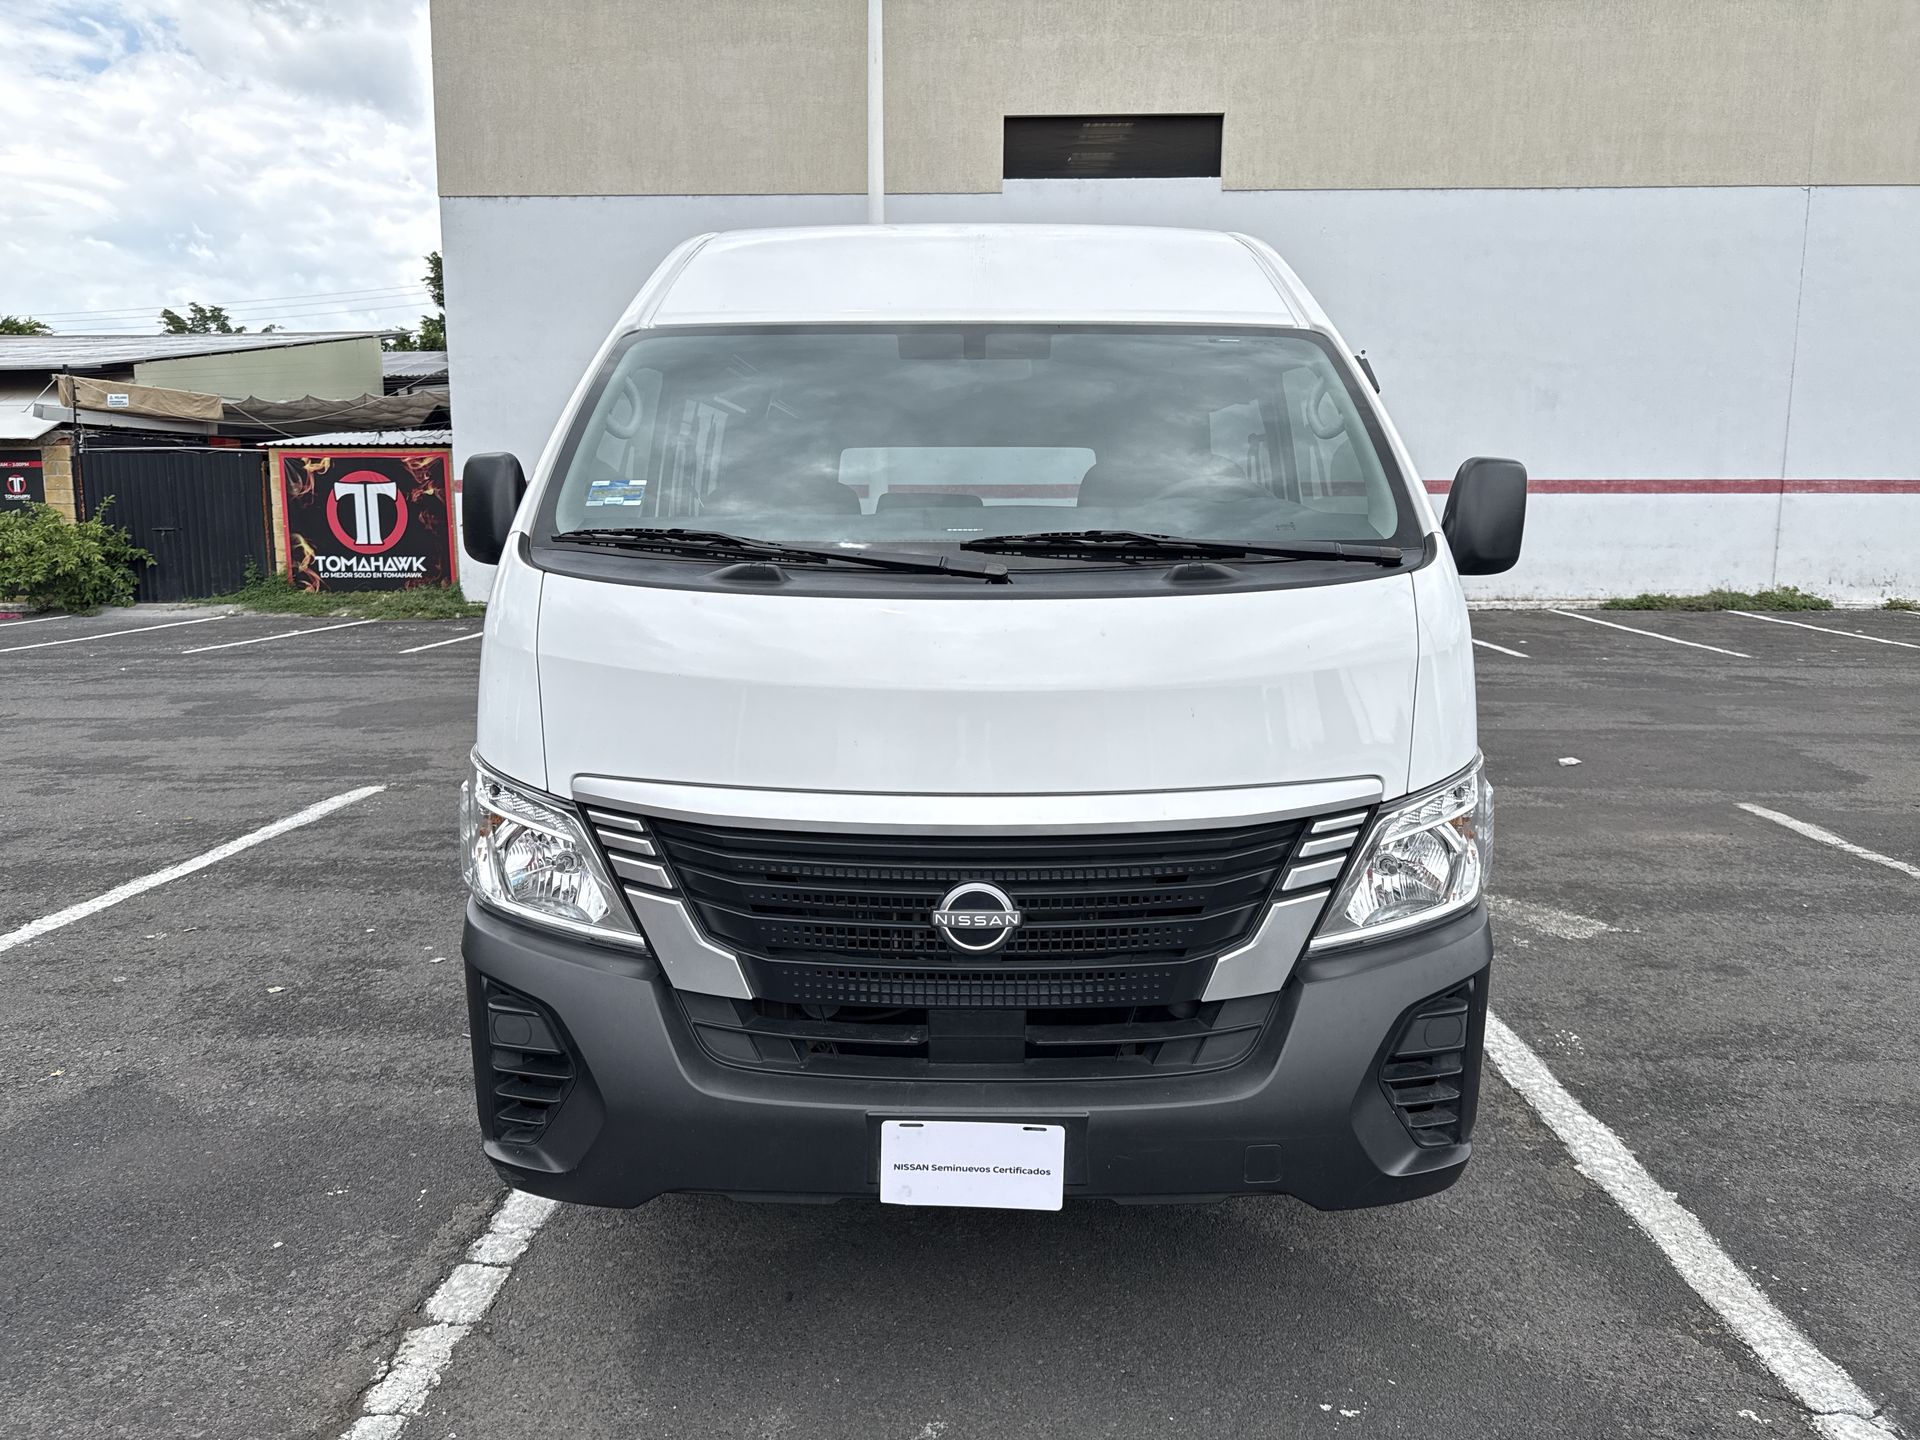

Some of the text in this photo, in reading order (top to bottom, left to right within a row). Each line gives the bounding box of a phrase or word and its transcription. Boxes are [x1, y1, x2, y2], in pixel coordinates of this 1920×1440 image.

[315, 555, 427, 572] TOMAHAWK
[935, 913, 1018, 926] NISSAN
[893, 1163, 1052, 1176] NISSAN Seminuevos Certificados
